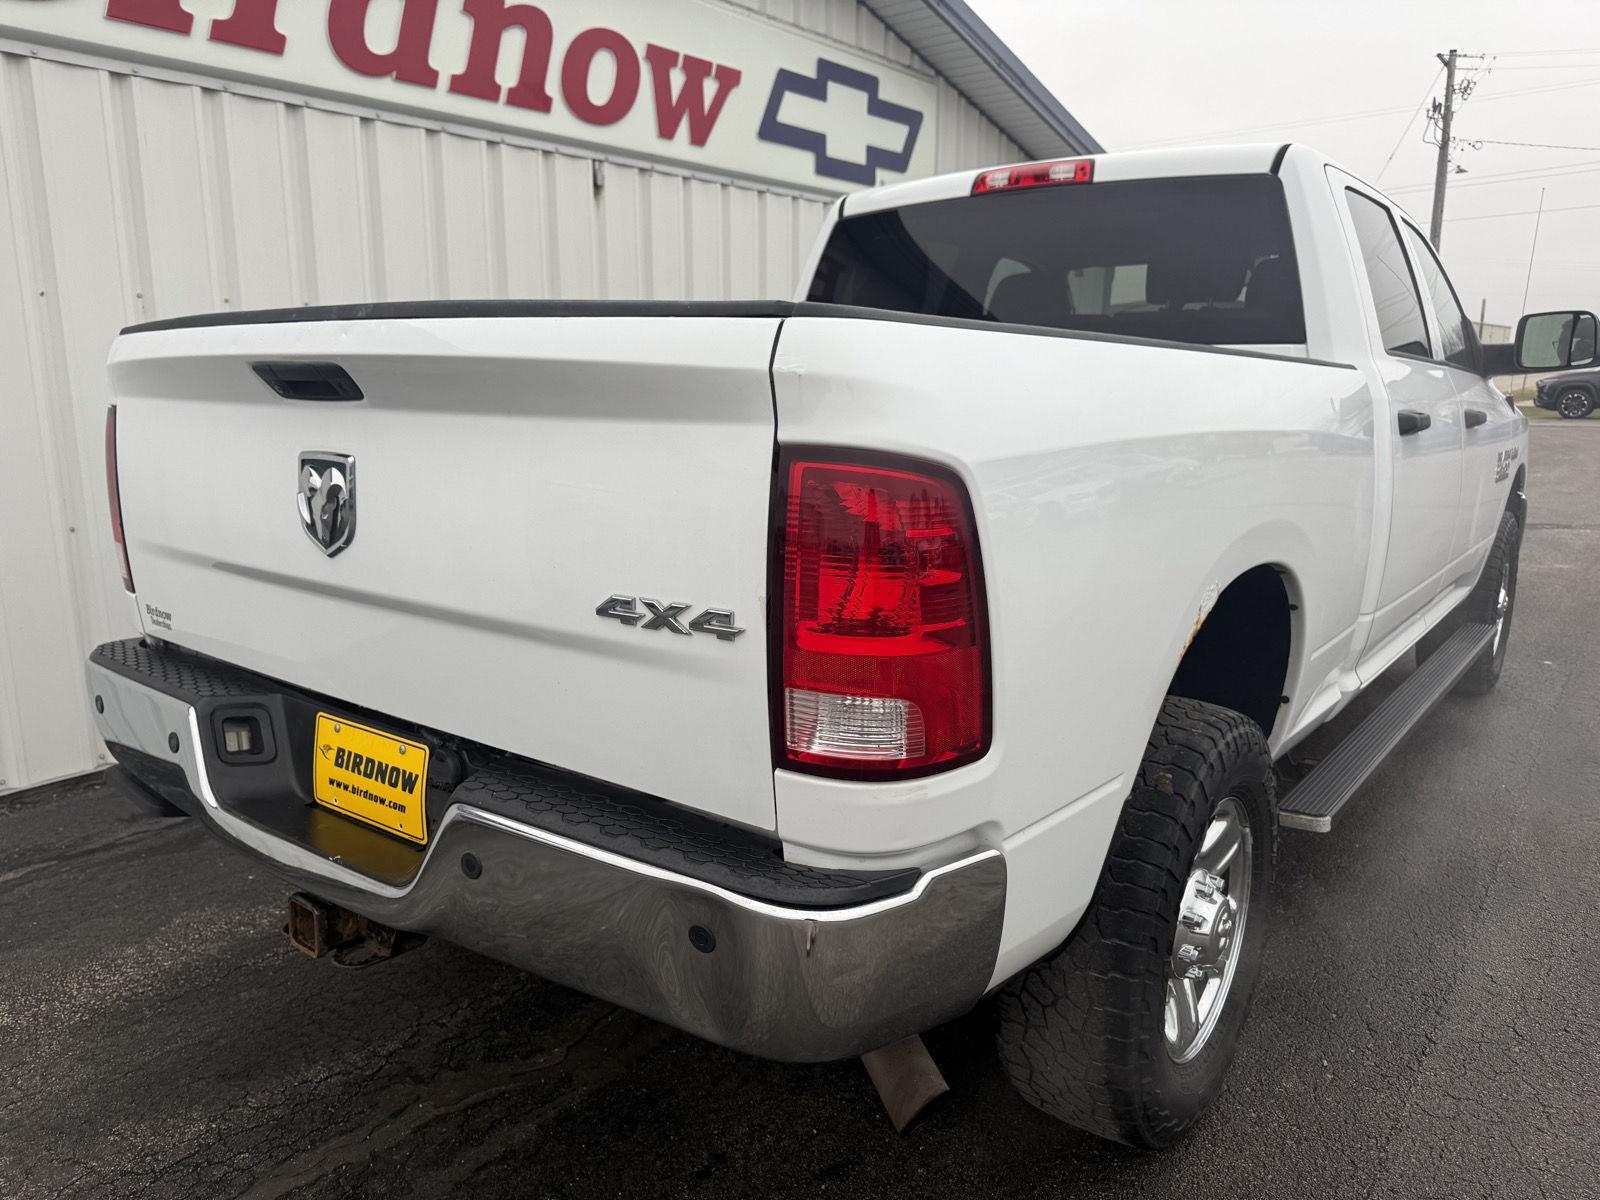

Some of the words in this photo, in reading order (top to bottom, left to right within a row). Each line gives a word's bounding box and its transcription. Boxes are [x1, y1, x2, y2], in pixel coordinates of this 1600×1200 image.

[104, 0, 742, 148] dnow
[333, 746, 420, 795] BIRDNOW
[328, 777, 407, 814] www.birdnow.com
